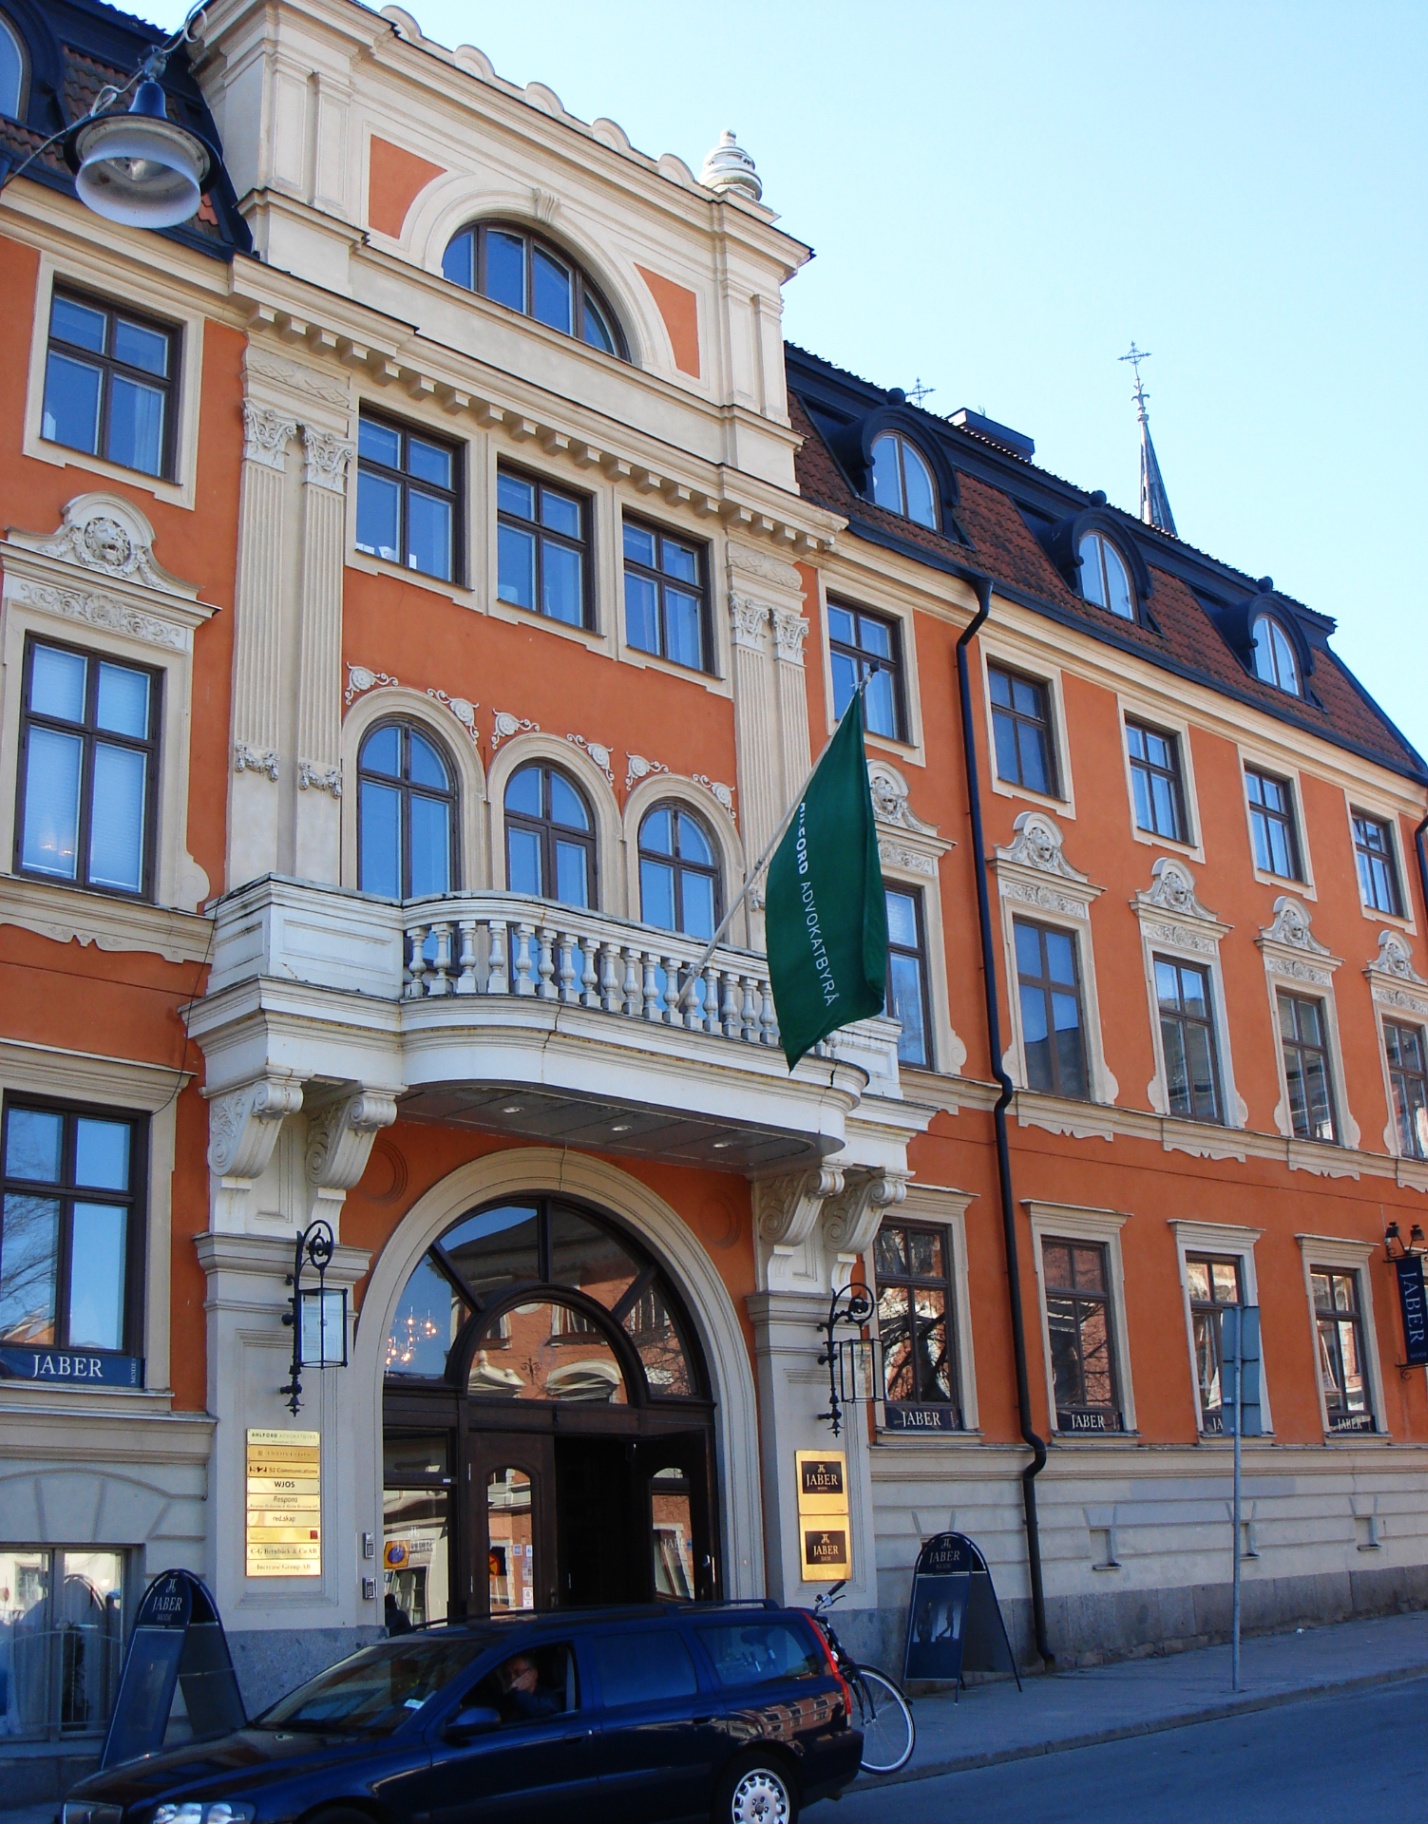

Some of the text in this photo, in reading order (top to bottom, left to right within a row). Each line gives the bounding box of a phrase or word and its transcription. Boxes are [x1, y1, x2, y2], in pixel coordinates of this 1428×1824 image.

[801, 881, 840, 1007] ADVOKATBYRÅ
[1400, 1272, 1425, 1344] JABER
[32, 1354, 104, 1378] JABER
[902, 1411, 942, 1428] JABER
[1071, 1414, 1106, 1430] JABER
[1337, 1417, 1363, 1431] JABER
[806, 1474, 839, 1487] JABER
[273, 1495, 298, 1504] Respons
[813, 1545, 839, 1557] JABER
[929, 1551, 961, 1565] JABER
[152, 1597, 183, 1612] JABER
